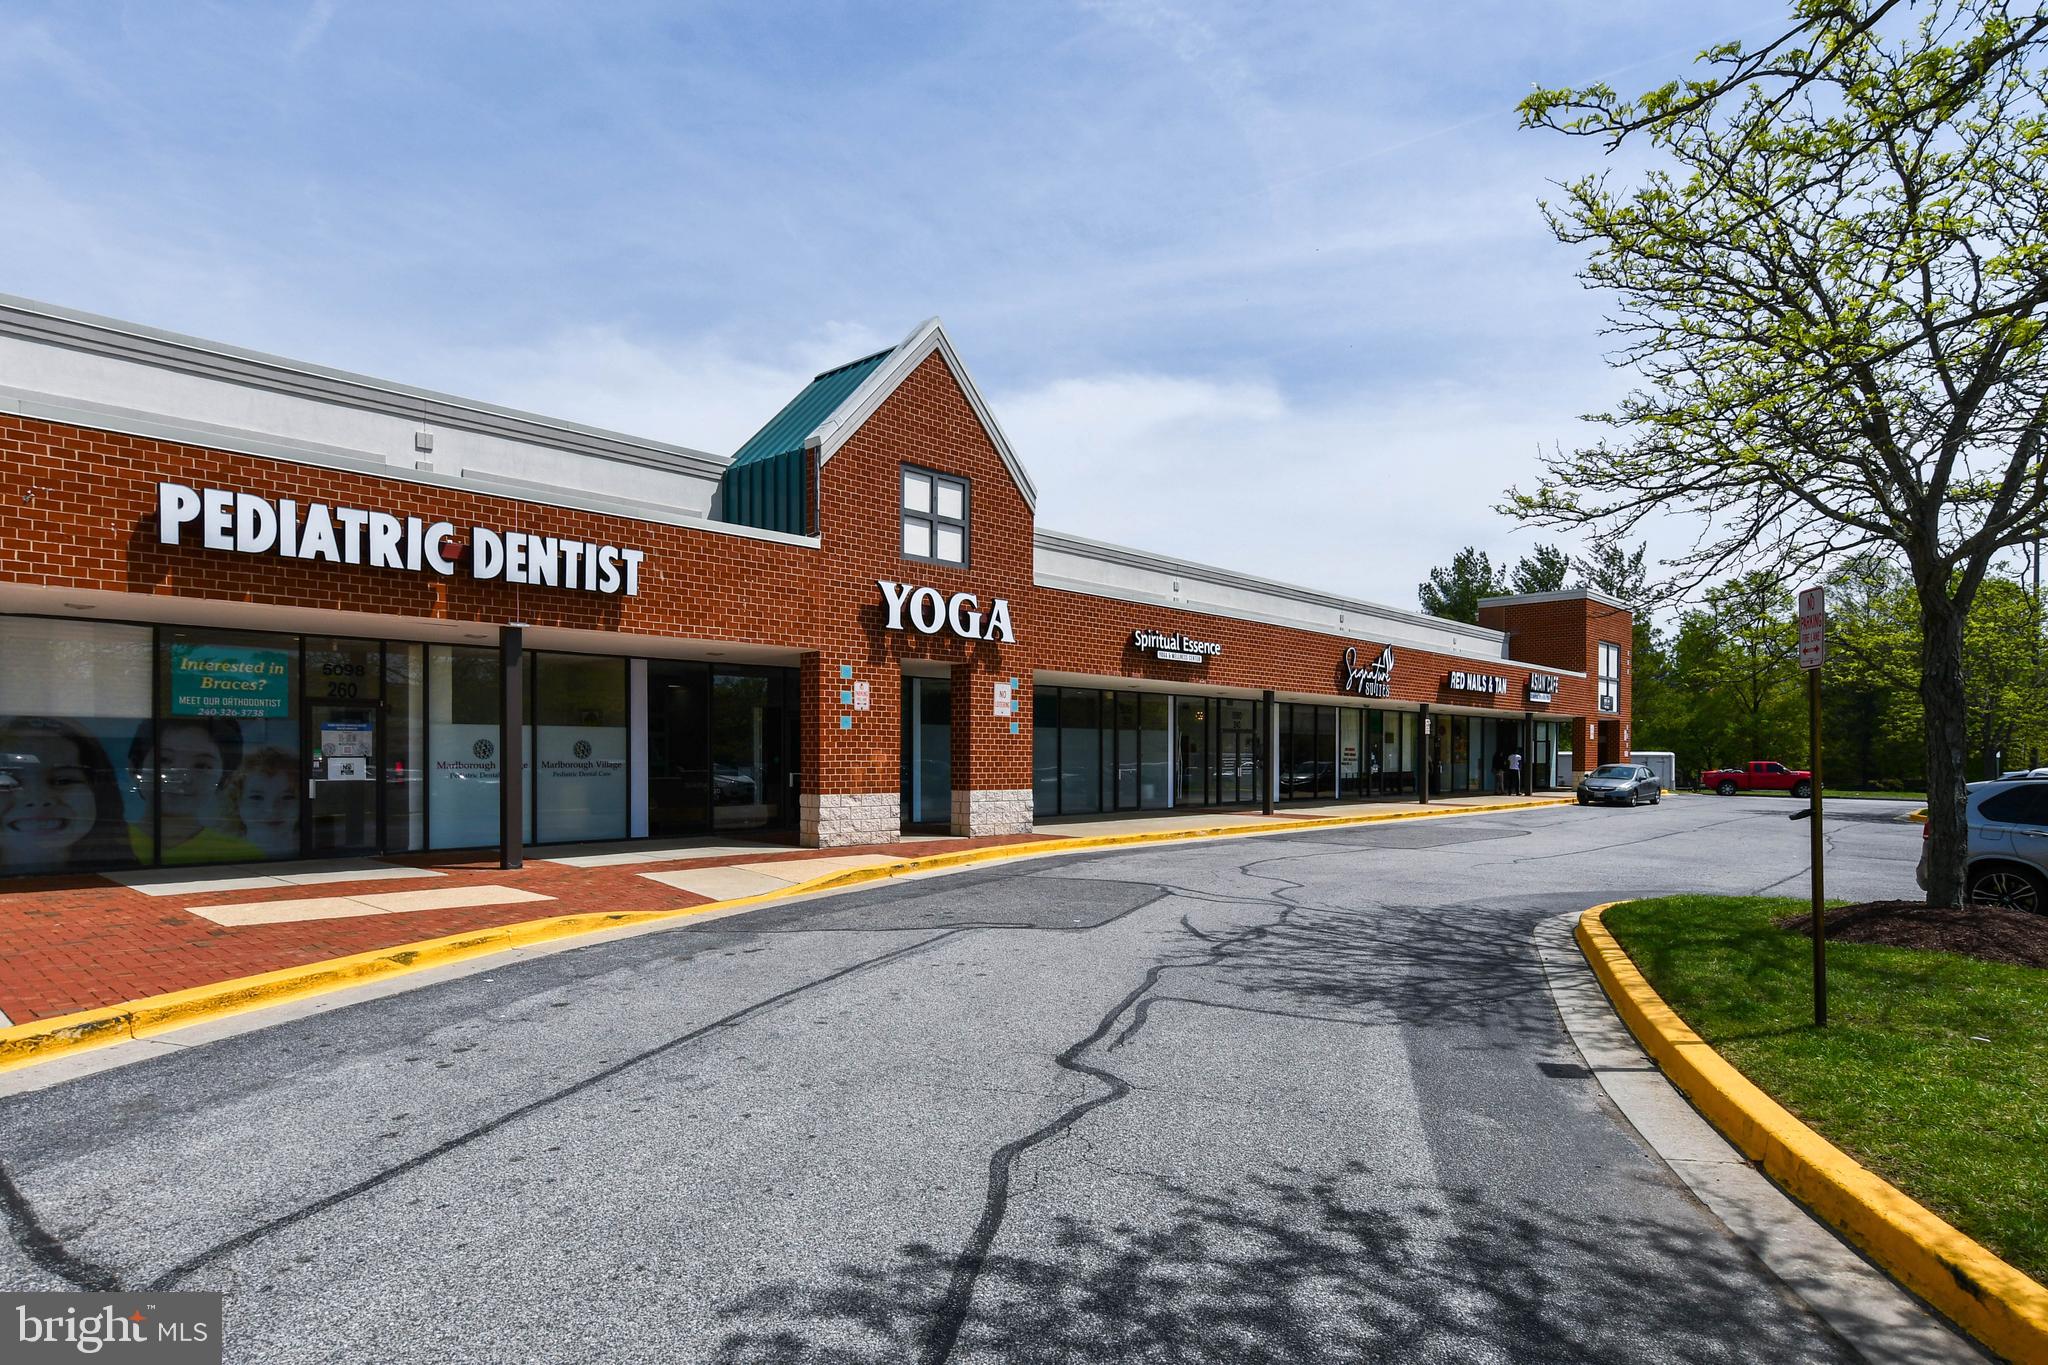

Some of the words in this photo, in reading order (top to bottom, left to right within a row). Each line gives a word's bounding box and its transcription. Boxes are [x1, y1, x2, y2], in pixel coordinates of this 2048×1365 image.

[158, 482, 455, 577] PEDIATRIC
[473, 526, 644, 597] DENTIST
[877, 580, 1016, 643] YOGA
[1134, 629, 1180, 652] Spiritual
[1183, 636, 1221, 656] Essence
[179, 657, 265, 674] Interested
[269, 662, 285, 675] in
[1345, 646, 1392, 694] Signature
[200, 676, 268, 691] Braces?
[327, 681, 358, 698] 260
[1365, 682, 1390, 698] SUITES
[1450, 671, 1466, 690] RED
[1466, 673, 1487, 693] NAILS
[1488, 675, 1494, 693] &
[1495, 677, 1508, 695] TAN
[178, 695, 201, 706] MEET
[203, 696, 220, 706] OUR
[222, 697, 282, 708] ORTHODONTIST
[197, 707, 264, 717] 240-326-3738
[437, 761, 496, 771] Marlborough
[541, 760, 594, 771] Marlborough
[596, 760, 623, 771] Village
